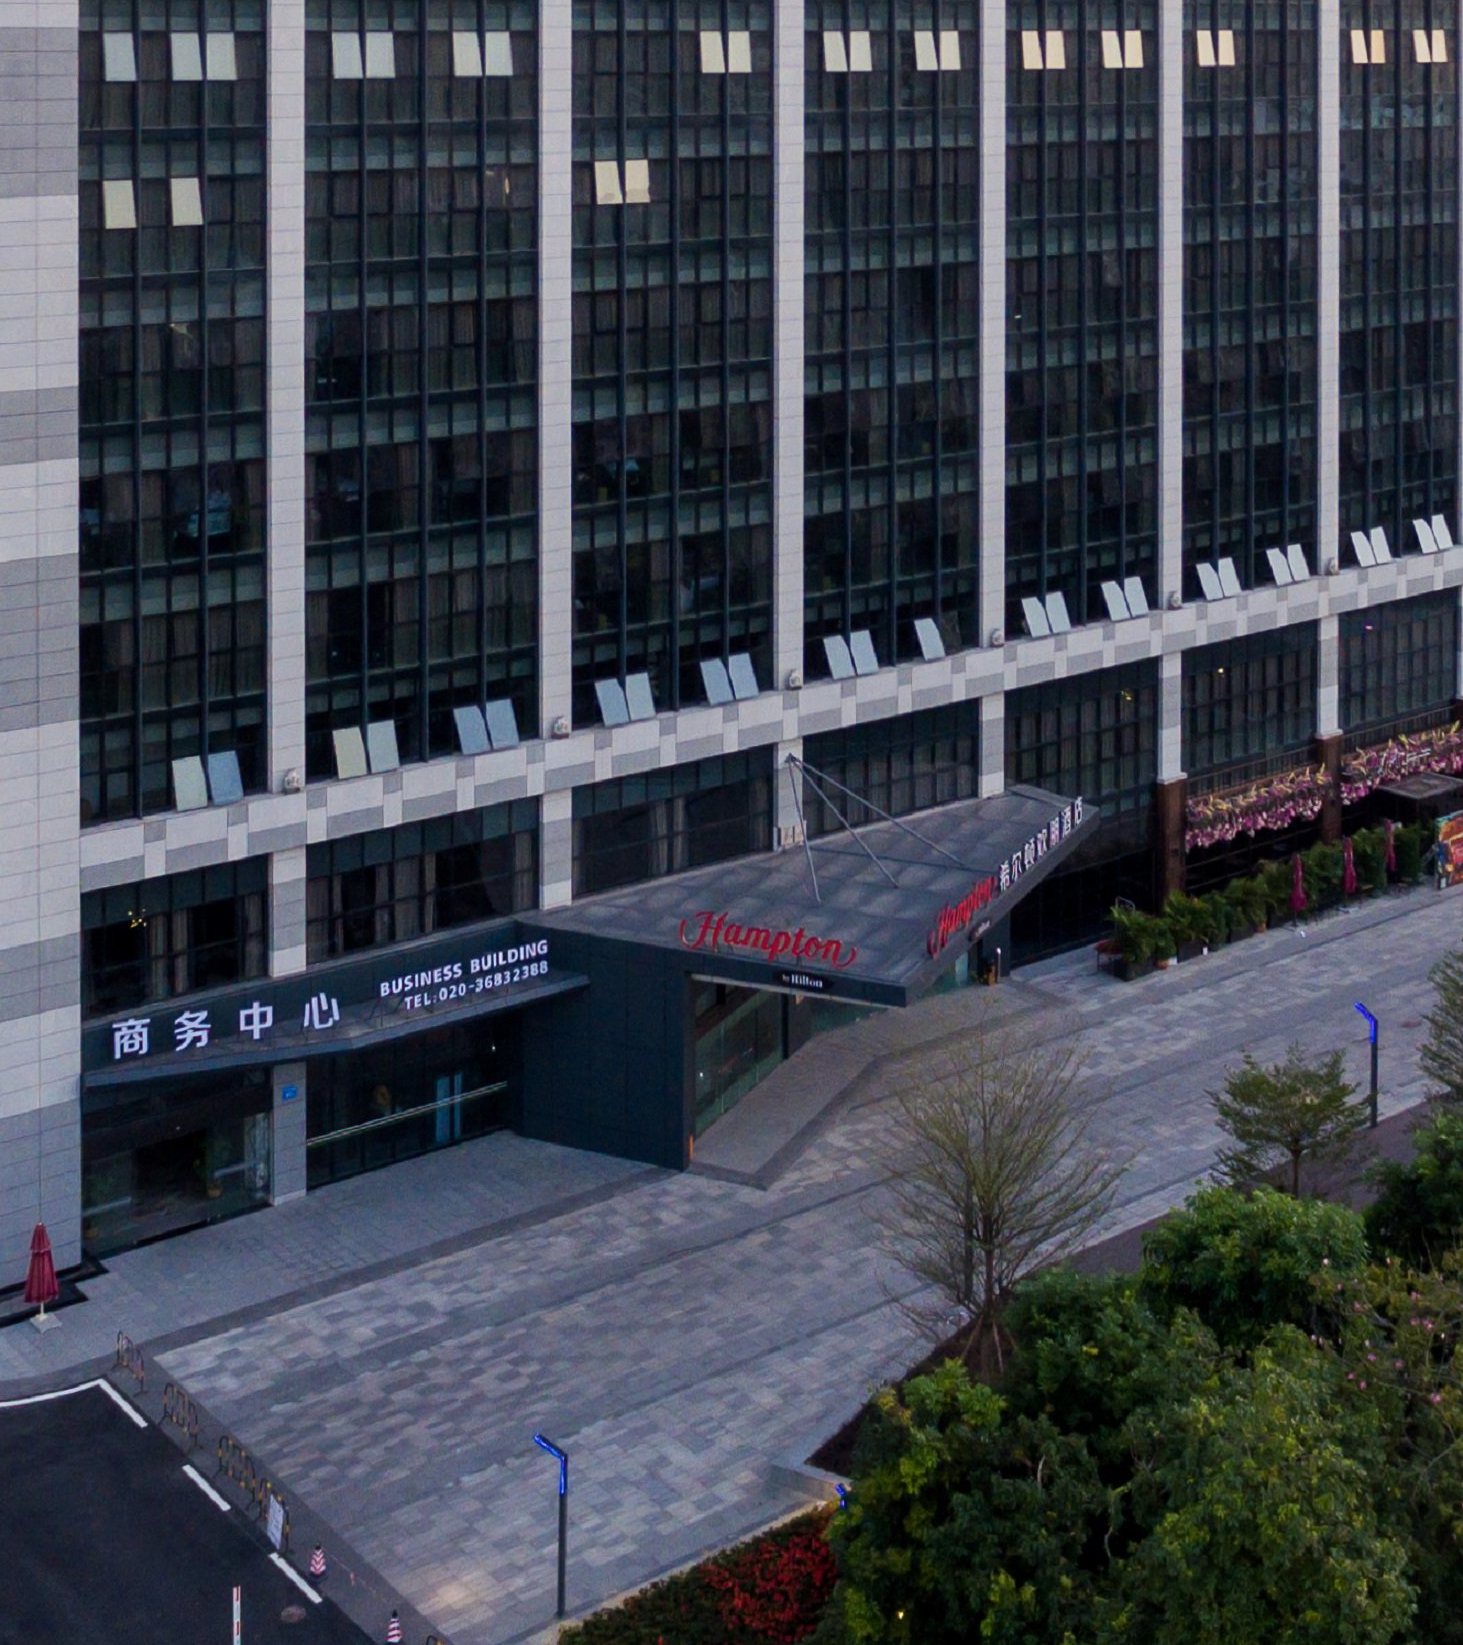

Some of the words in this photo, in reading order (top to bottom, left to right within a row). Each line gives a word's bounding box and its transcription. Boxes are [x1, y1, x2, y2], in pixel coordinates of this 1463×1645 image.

[380, 961, 463, 998] BUSINESS
[470, 940, 549, 974] BUILDING
[679, 910, 857, 970] Hampton
[791, 973, 824, 989] Hilton
[112, 992, 341, 1060] 商务中心
